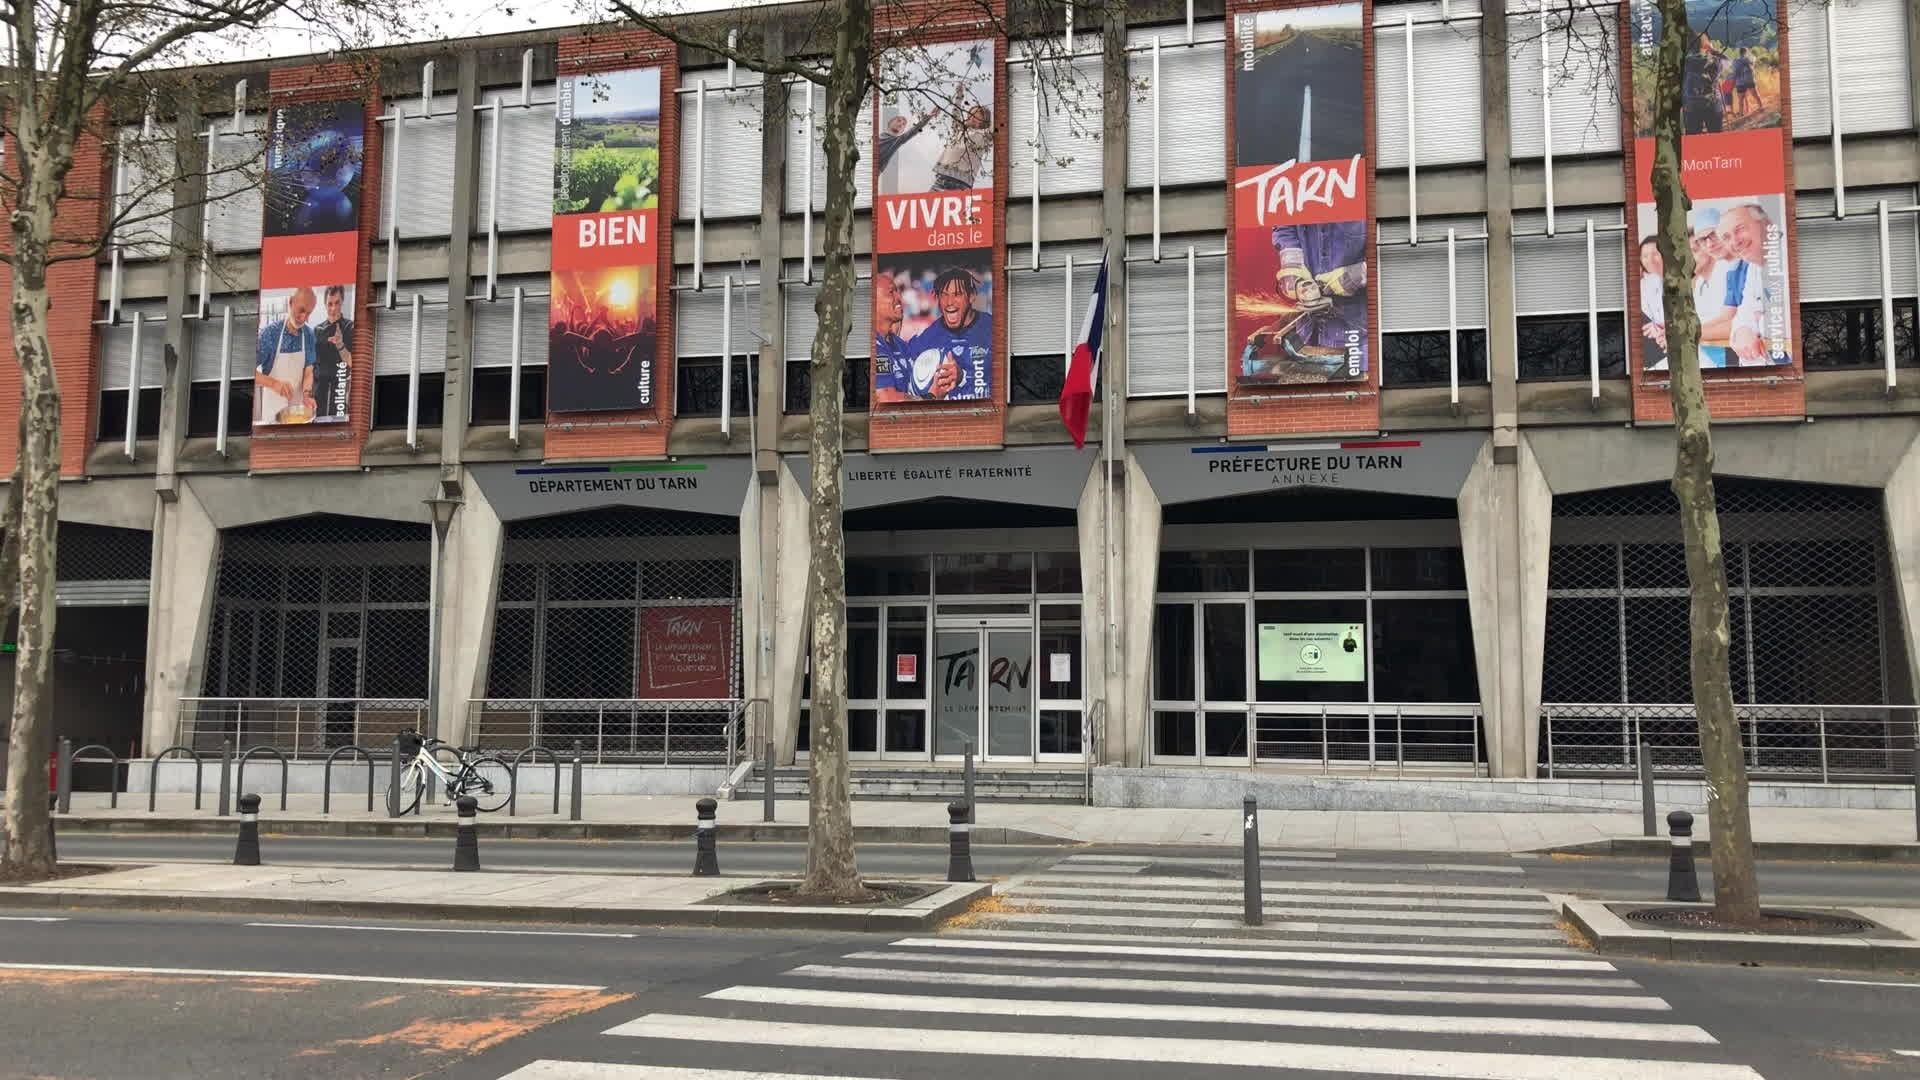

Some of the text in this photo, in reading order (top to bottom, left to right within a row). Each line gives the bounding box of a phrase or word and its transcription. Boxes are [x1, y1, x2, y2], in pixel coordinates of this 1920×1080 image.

[1239, 17, 1255, 72] mobilité
[559, 80, 573, 126] durable
[1234, 153, 1361, 227] TARN
[578, 214, 647, 249] BIEN
[885, 194, 983, 231] VIVRE
[927, 227, 983, 248] dans le
[1763, 223, 1784, 277] publics
[1344, 329, 1360, 377] emploi
[1767, 306, 1785, 360] service
[334, 361, 347, 418] solidarité
[638, 360, 650, 404] culture
[972, 359, 987, 395] sport
[848, 465, 1033, 481] LIBERTÉ ÉGALITÉ FRATERNITÉ
[1208, 455, 1403, 473] PRÉFECTURE DU TARN
[1271, 473, 1341, 484] ANNEXE
[529, 477, 698, 493] DÉPARTEMENT DU TARN
[662, 615, 703, 637] TARN
[936, 647, 1032, 697] TARN
